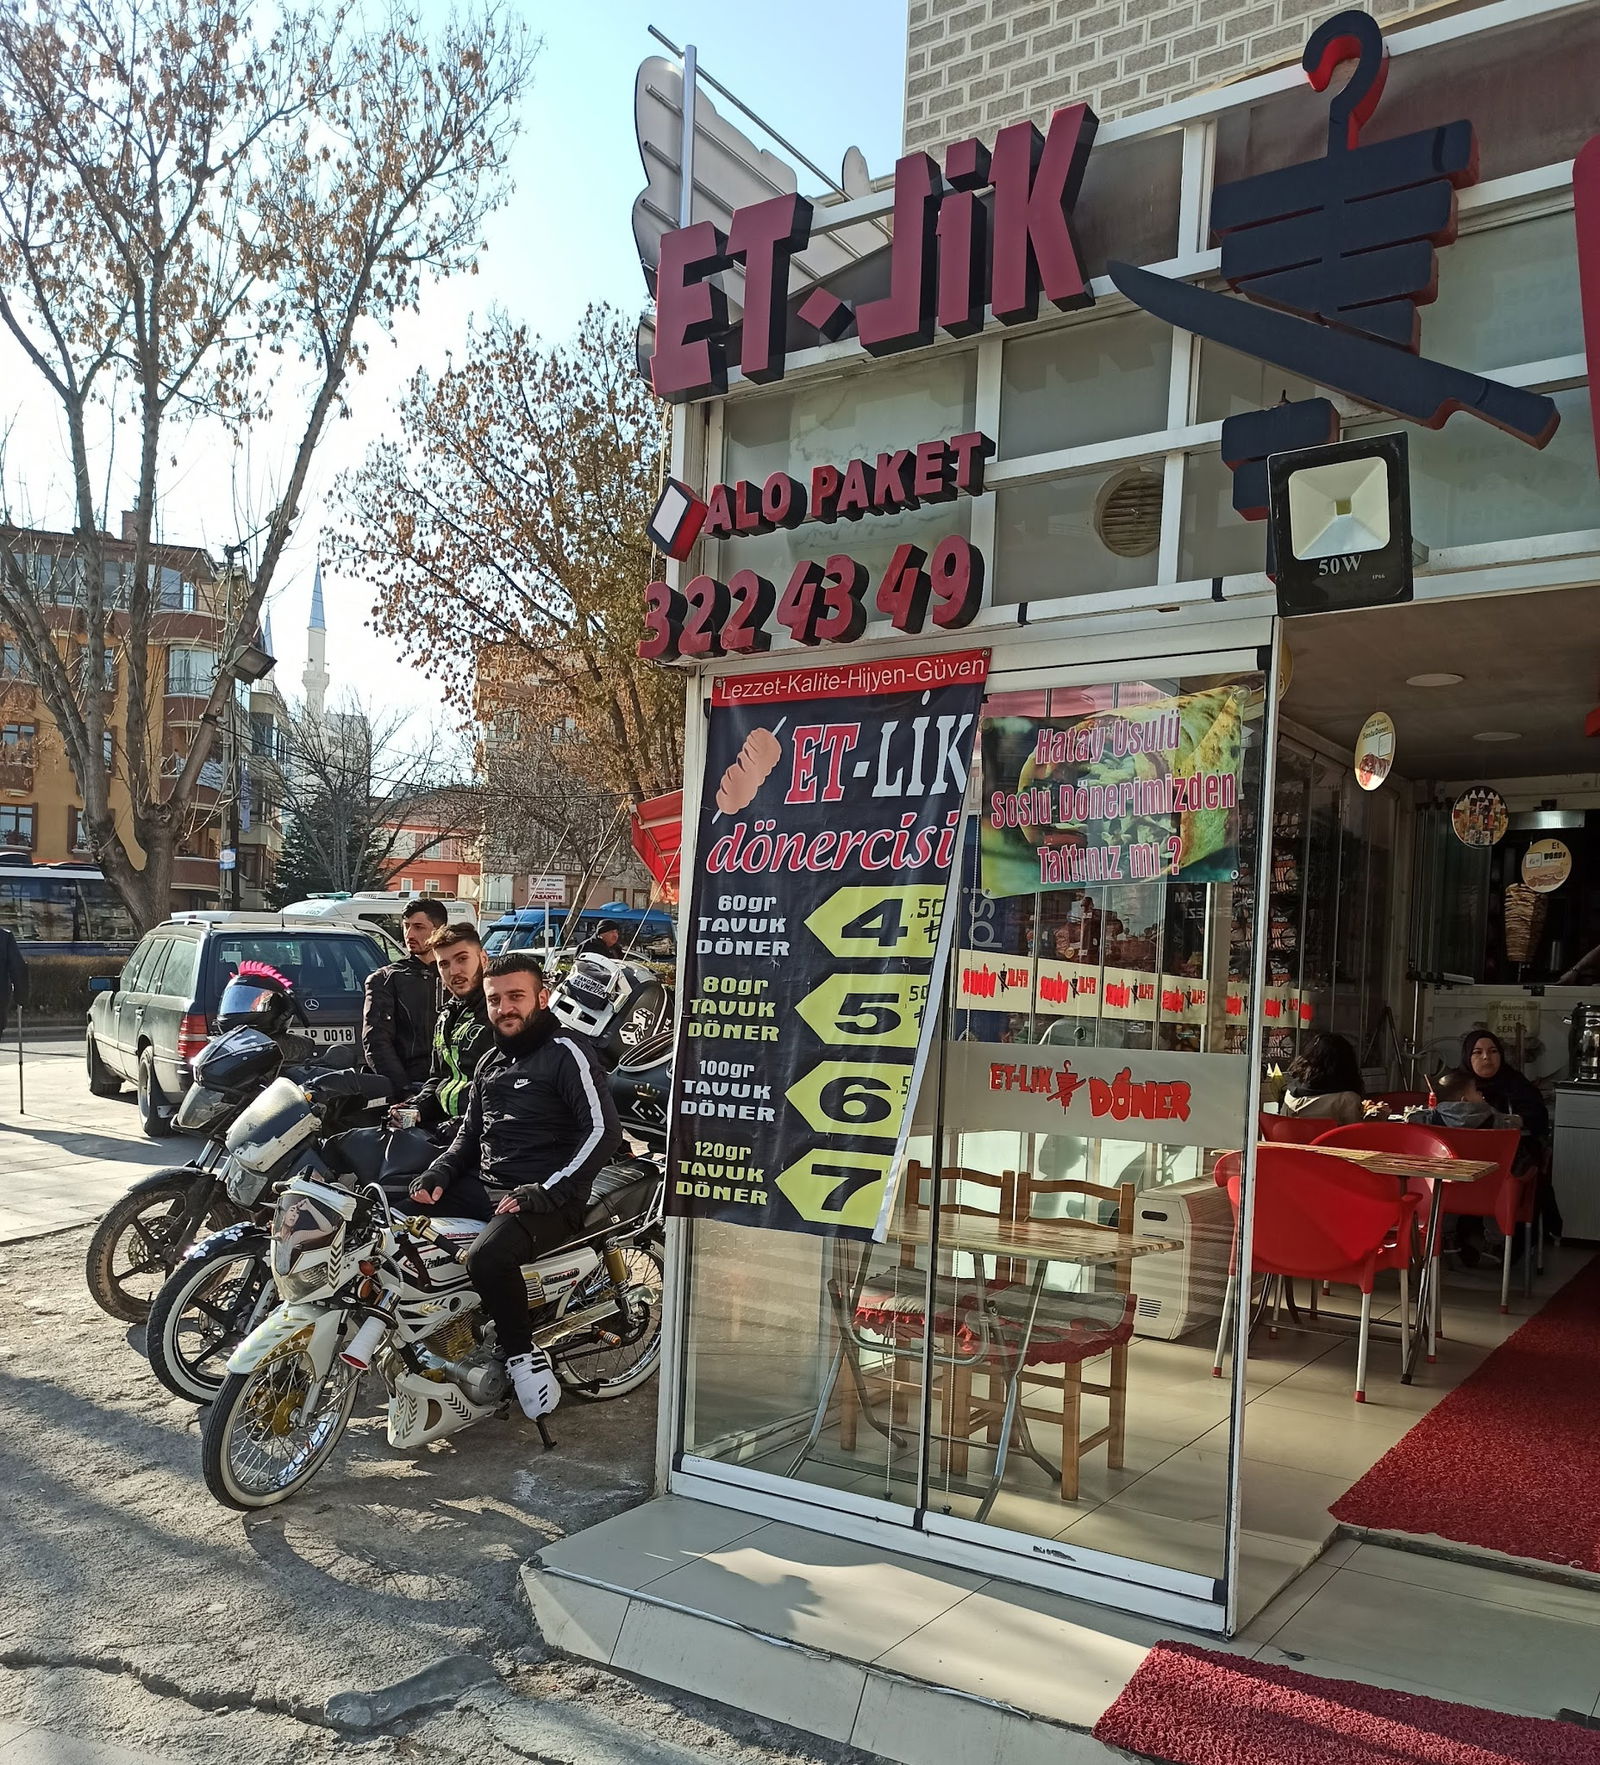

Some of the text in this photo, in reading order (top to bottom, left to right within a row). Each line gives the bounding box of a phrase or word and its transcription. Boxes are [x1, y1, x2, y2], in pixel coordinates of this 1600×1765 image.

[704, 431, 994, 538] ALO PAKET
[1318, 555, 1362, 576] 50W
[638, 535, 984, 661] 322 43 49
[721, 657, 985, 700] Lezzet-Kalite-Hijyen-Güven
[784, 690, 973, 804] ET-LİK
[1035, 710, 1181, 764] Hatay Usulü
[990, 771, 1236, 829] Soslu Dönerimizden
[706, 811, 960, 873] dönercisi
[718, 894, 777, 913] 60gr
[698, 916, 787, 934] TAVUK
[841, 898, 909, 947] 4
[696, 937, 790, 957] DÖNER
[703, 976, 769, 996] 80gr
[690, 999, 776, 1018] TAVUK
[834, 993, 902, 1035] 5
[324, 1030, 352, 1041] 0018
[687, 1020, 780, 1042] DÖNER
[700, 1060, 755, 1079] 100gr
[682, 1079, 772, 1100] TAVUK
[819, 1076, 892, 1124] 6
[680, 1100, 776, 1122] DÖNER
[694, 1141, 752, 1161] 120gr
[677, 1160, 765, 1183] TAVUK
[675, 1180, 768, 1205] DÖNER
[811, 1163, 882, 1212] 7
